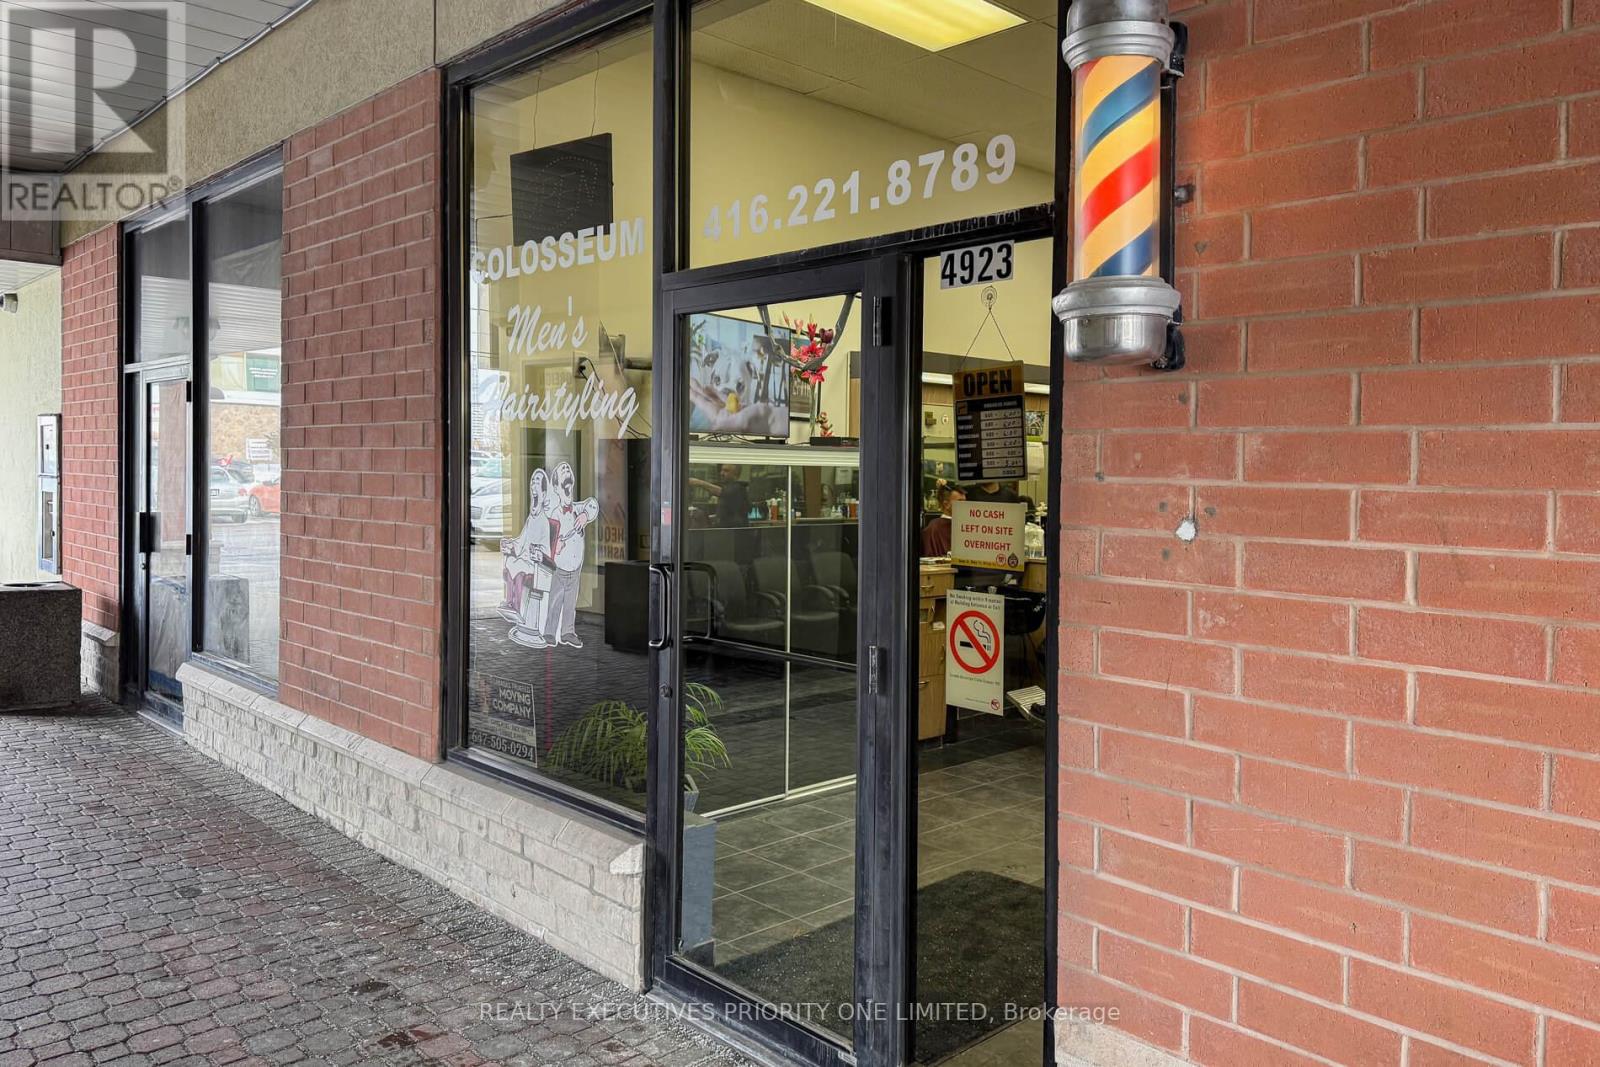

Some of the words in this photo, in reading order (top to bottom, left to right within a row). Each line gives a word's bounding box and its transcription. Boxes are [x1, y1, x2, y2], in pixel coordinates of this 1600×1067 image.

[703, 134, 1016, 241] 416.221.8789
[470, 217, 645, 284] COLOSSEUM
[941, 243, 1012, 287] 4923
[507, 295, 588, 356] Men's
[963, 369, 1013, 397] OPEN
[969, 509, 982, 518] NO
[983, 510, 1005, 519] CASH
[960, 524, 980, 534] LEFT
[981, 526, 993, 535] ON
[995, 526, 1013, 536] SITE
[964, 539, 1011, 552] OVERNIG85
[499, 687, 531, 705] MOVING
[492, 699, 531, 718] COMPANY
